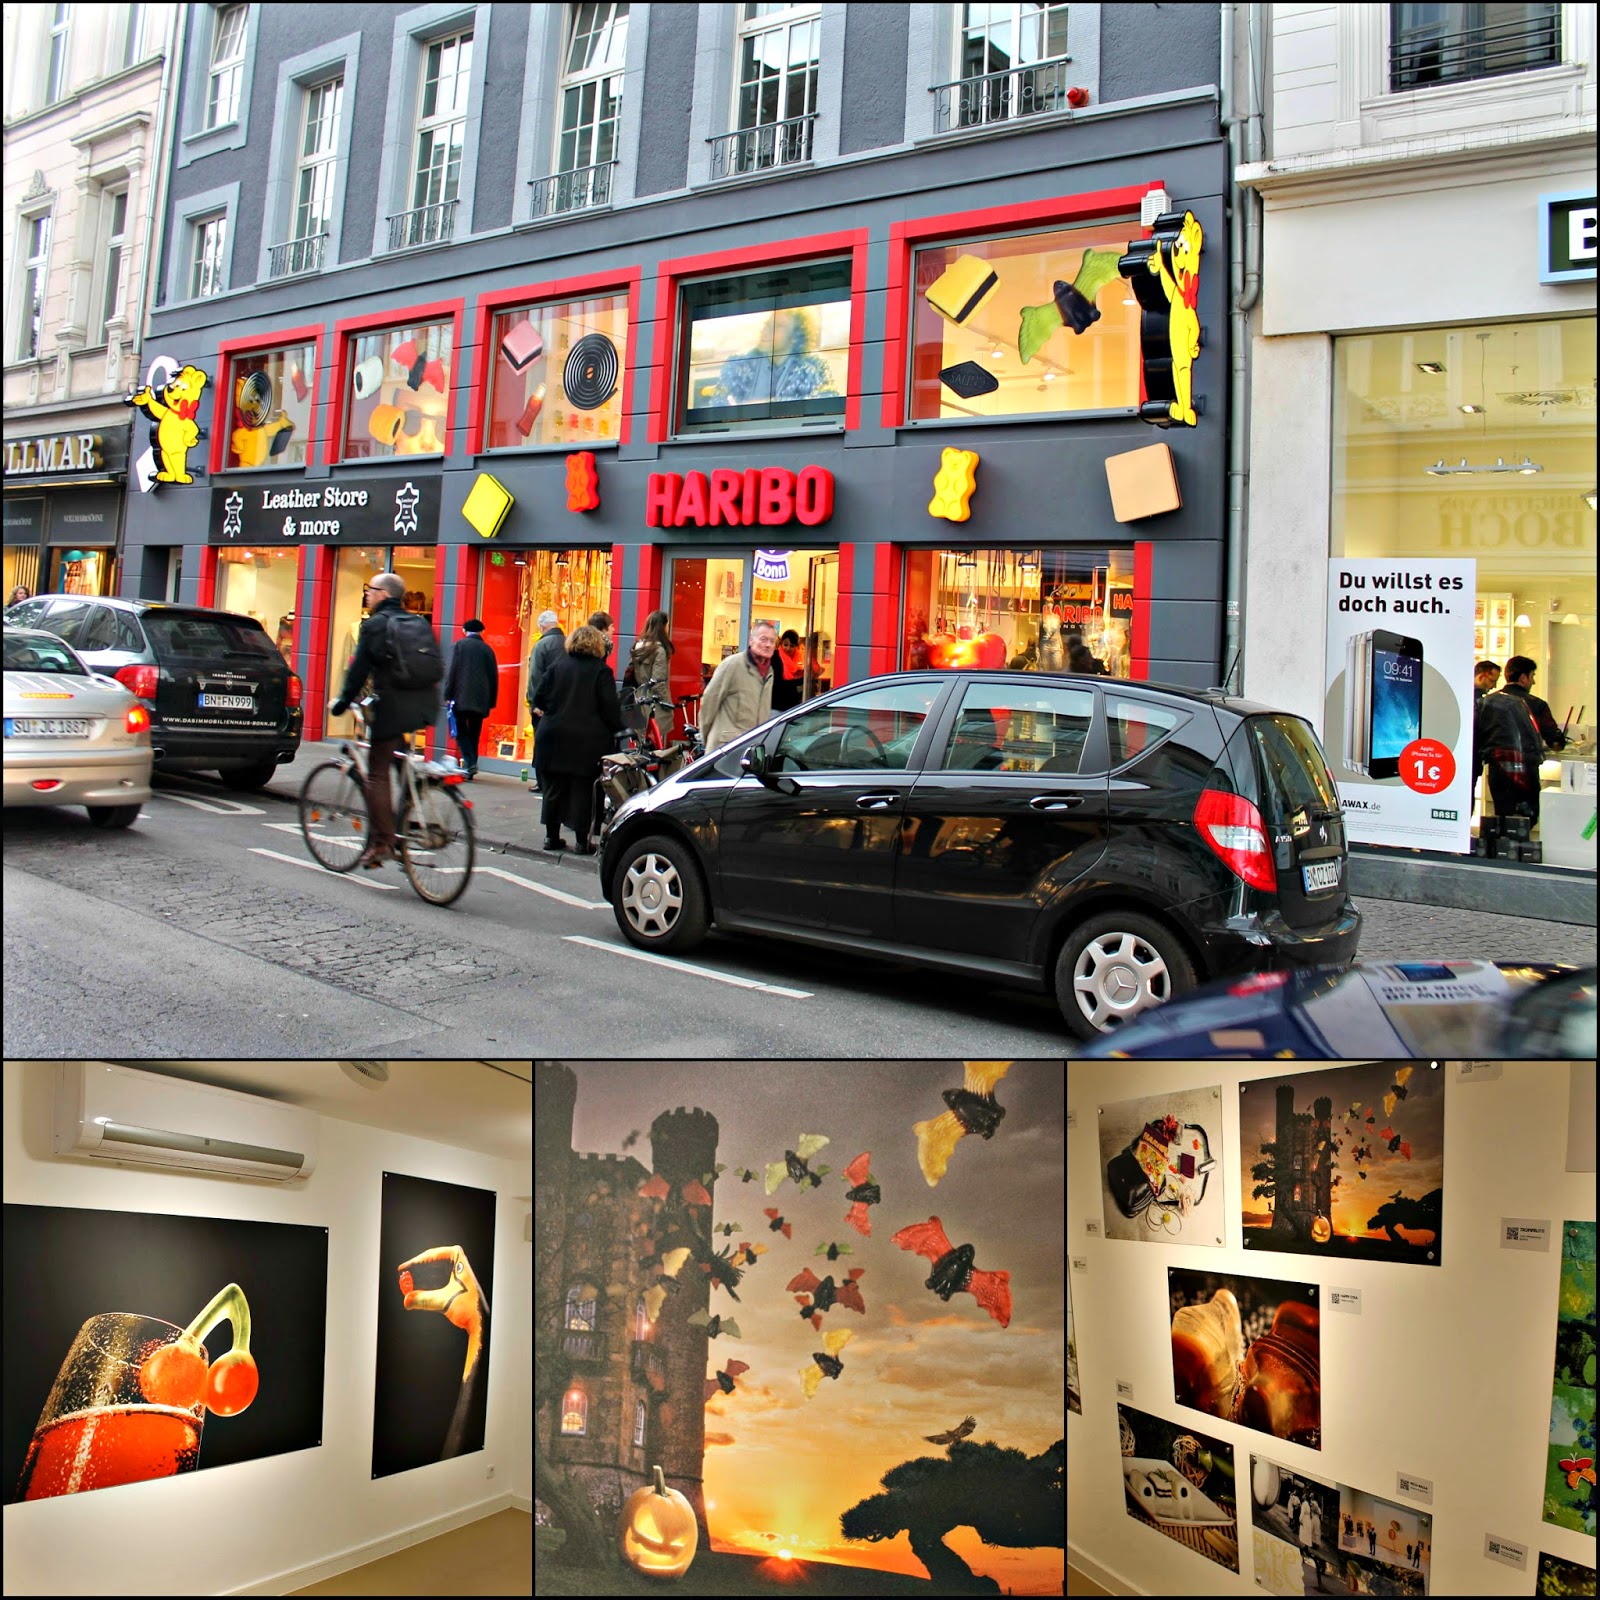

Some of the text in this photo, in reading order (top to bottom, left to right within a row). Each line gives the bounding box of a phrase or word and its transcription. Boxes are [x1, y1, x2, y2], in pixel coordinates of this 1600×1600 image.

[3, 434, 95, 475] LLMAR
[262, 486, 368, 510] Leather Store
[646, 464, 835, 528] HARIBO
[283, 516, 340, 537] & more
[757, 558, 786, 578] Bonn
[1340, 572, 1464, 590] Du willst es
[1338, 595, 1451, 614] doch auch.
[1383, 660, 1413, 678] 09:41
[204, 695, 217, 706] BN
[14, 720, 31, 734] SU
[162, 716, 277, 727] WWW.DASIMMOBILIENHAUS-BONN.DE
[1432, 810, 1456, 820] BASE
